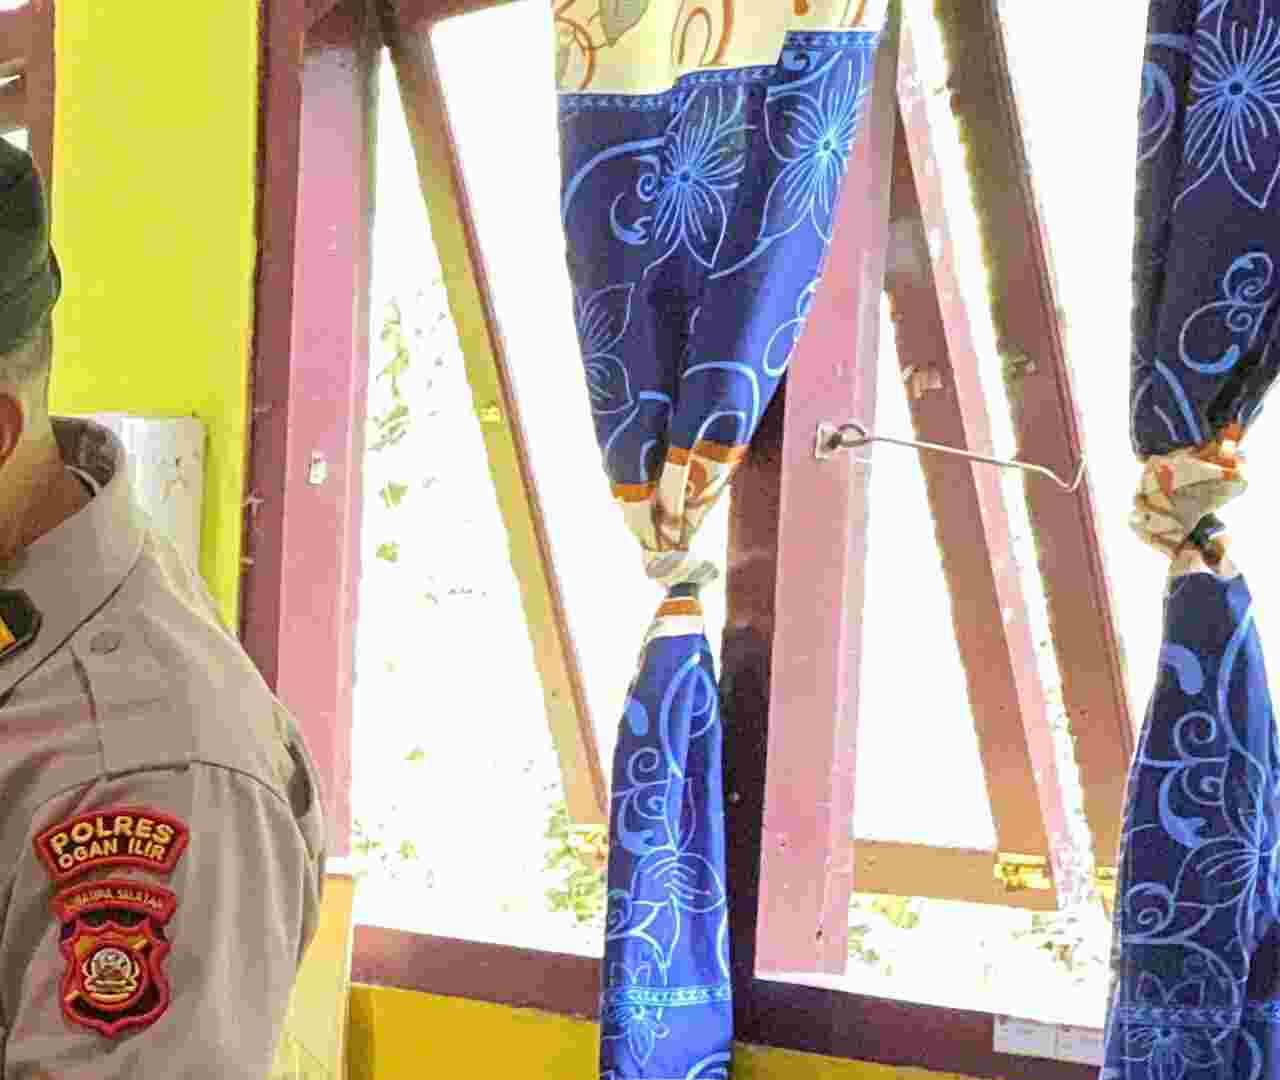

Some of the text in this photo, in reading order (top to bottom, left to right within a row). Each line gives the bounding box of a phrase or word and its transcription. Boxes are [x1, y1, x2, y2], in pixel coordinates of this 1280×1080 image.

[49, 815, 176, 856] POLRES
[58, 836, 166, 870] OGAN ILIR
